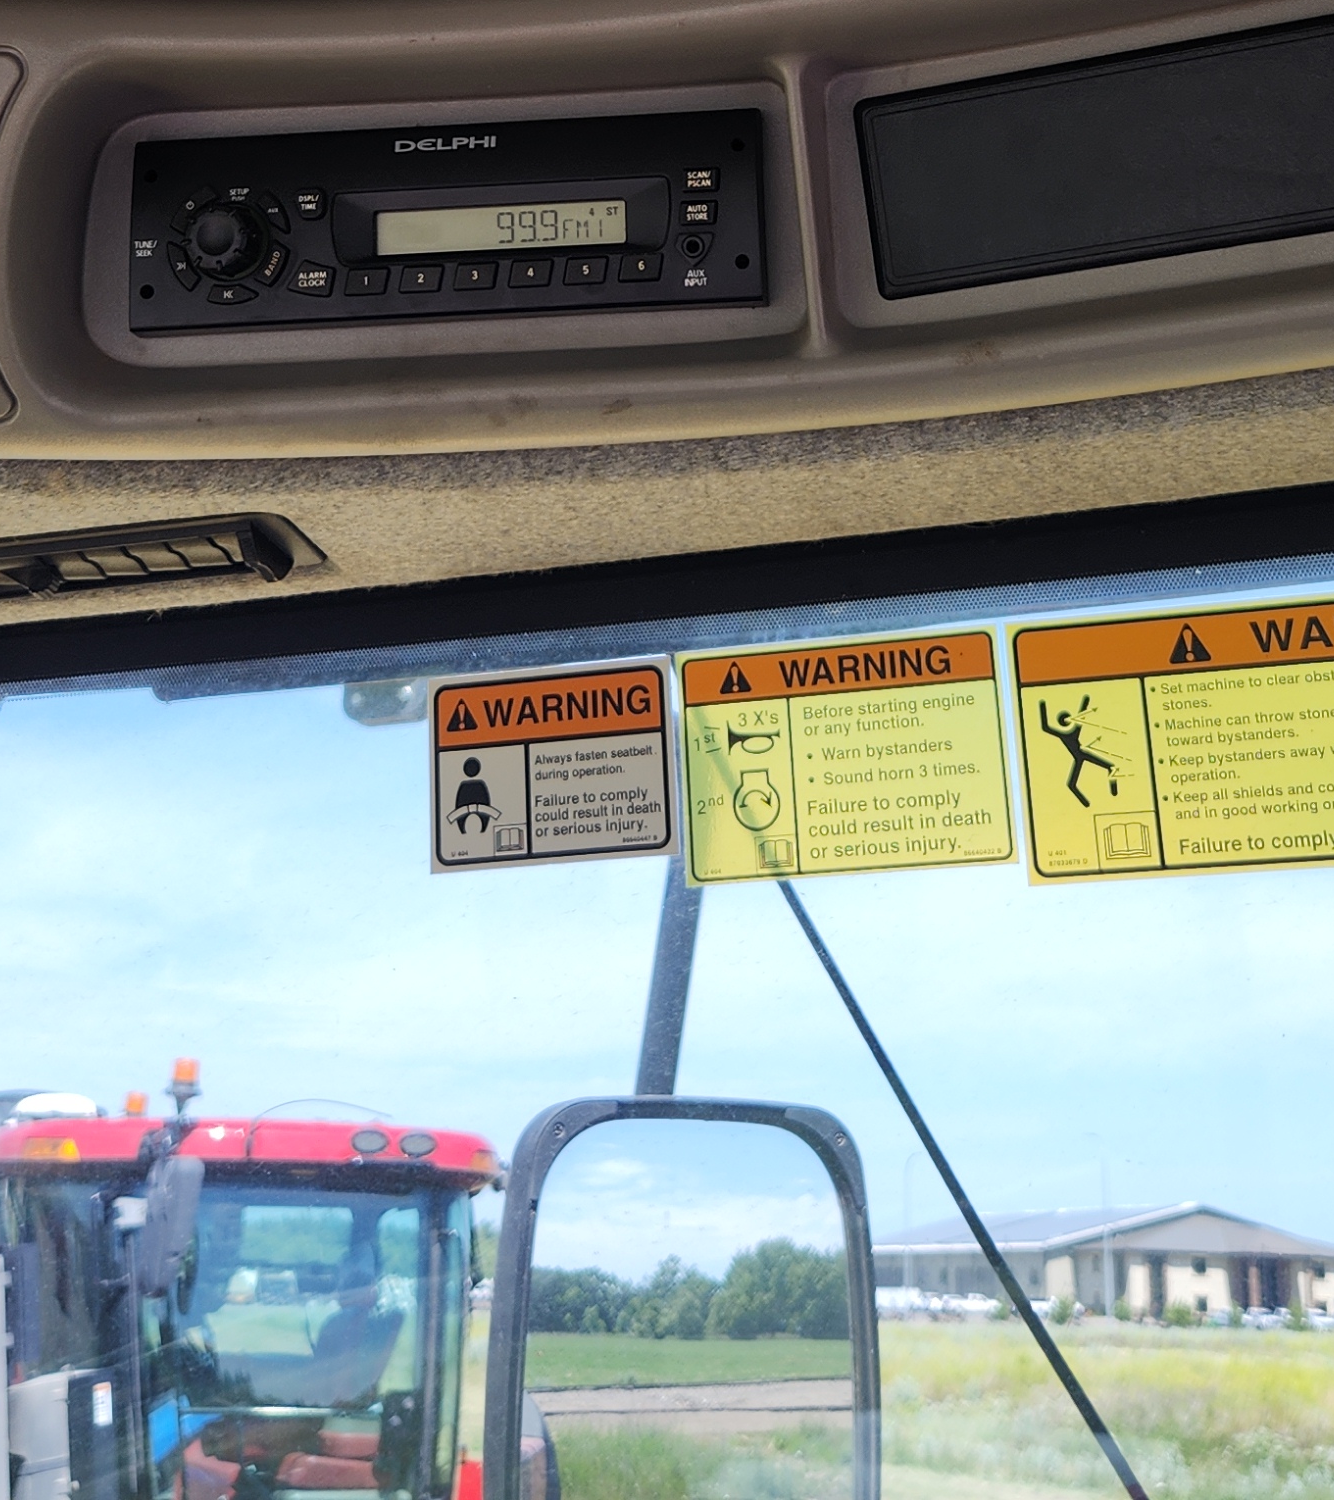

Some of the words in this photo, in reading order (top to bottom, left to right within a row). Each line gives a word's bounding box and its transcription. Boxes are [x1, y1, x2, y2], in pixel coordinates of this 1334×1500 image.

[394, 135, 497, 153] DELPHI
[687, 171, 711, 179] SCAN/
[687, 178, 711, 187] PSCAN
[229, 188, 250, 196] SETUP
[589, 207, 594, 217] 4
[606, 206, 618, 216] ST
[687, 213, 708, 221] STORE
[497, 210, 558, 244] 99.9
[134, 240, 158, 248] TUNE/
[264, 251, 281, 276] BAND
[582, 265, 589, 275] 5
[638, 261, 644, 271] 6
[364, 277, 368, 285] 1
[417, 274, 424, 283] 2
[472, 271, 478, 280] 3
[527, 268, 534, 277] 4
[685, 277, 707, 286] INPUT
[778, 645, 950, 687] WARNING
[1160, 683, 1182, 694] Set
[1187, 678, 1244, 692] machine
[1248, 677, 1261, 686] to
[1266, 674, 1299, 685] clear
[483, 684, 650, 727] WARNING
[803, 705, 852, 719] Before
[858, 698, 916, 714] starting
[922, 693, 973, 710] engine
[1162, 699, 1211, 710] stones.
[737, 712, 747, 727] 3
[753, 710, 779, 726] X's
[804, 725, 818, 735] or
[825, 723, 850, 736] any
[856, 715, 923, 731] function.
[1165, 716, 1221, 730] Machine
[1226, 715, 1250, 725] can
[1254, 712, 1293, 723] throw
[1166, 732, 1212, 746] toward
[1217, 727, 1298, 745] bystanders.
[534, 754, 571, 765] Always
[575, 751, 607, 761] fasten
[821, 747, 860, 760] Warn
[866, 739, 952, 759] bystanders
[1169, 754, 1203, 767] Keep
[1207, 748, 1285, 766] bystanders
[1290, 746, 1324, 758] away
[535, 769, 568, 780] during
[572, 765, 624, 778] operation.
[823, 768, 872, 784] Sound
[878, 768, 913, 780] horn
[919, 764, 927, 777] 3
[933, 762, 979, 776] times.
[1170, 768, 1239, 785] operation.
[1173, 791, 1207, 804] Keep
[1212, 788, 1227, 800] all
[1233, 785, 1282, 798] shields
[1288, 782, 1313, 794] and
[697, 794, 724, 815] 2nd
[1175, 807, 1199, 819] and
[1204, 806, 1217, 817] in
[1221, 803, 1256, 819] good
[1261, 799, 1317, 813] working
[1179, 837, 1241, 854] Failure
[1247, 836, 1264, 849] to
